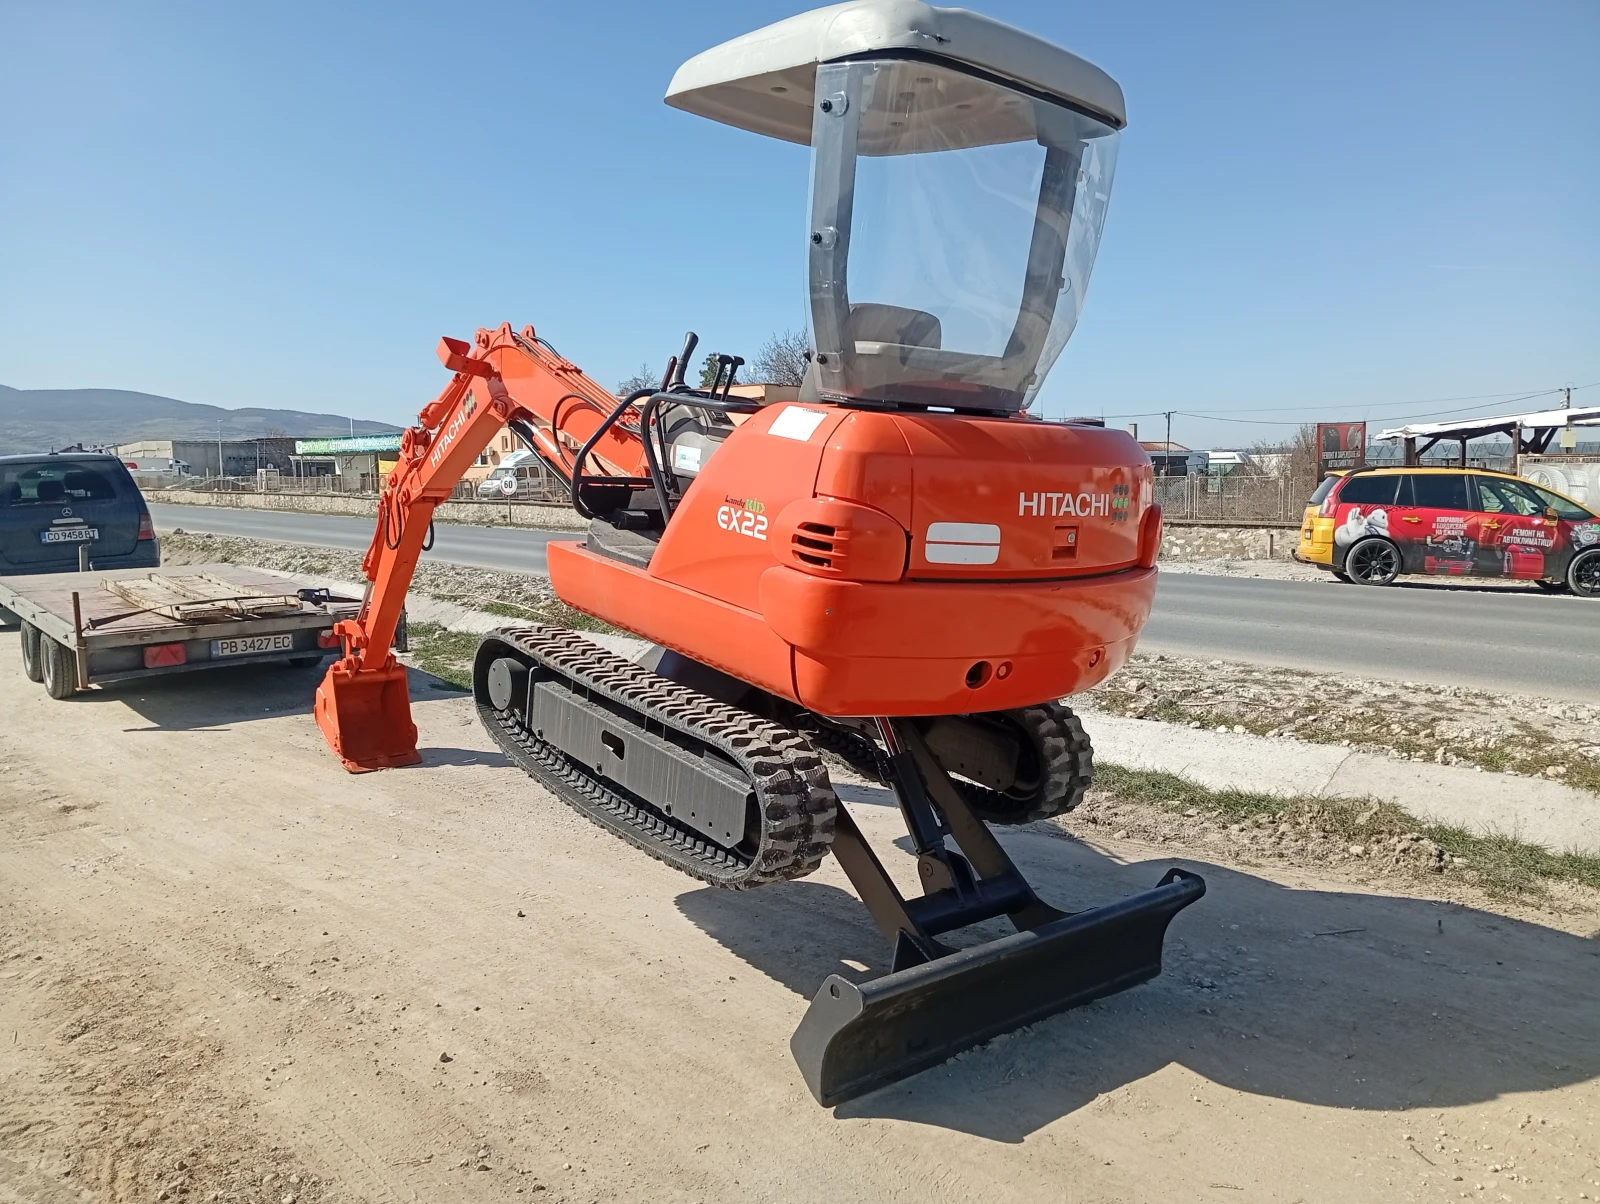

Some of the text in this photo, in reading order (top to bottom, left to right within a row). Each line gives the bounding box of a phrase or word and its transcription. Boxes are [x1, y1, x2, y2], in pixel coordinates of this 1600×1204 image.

[430, 410, 466, 467] HITACHI
[504, 480, 513, 488] 60
[725, 494, 746, 508] Landy
[1018, 492, 1110, 517] HITACHI
[717, 505, 769, 541] EX22
[61, 530, 84, 540] 9458
[1512, 528, 1545, 538] РЕМОНТ НА
[1502, 536, 1554, 547] АВТОКЛИМАТИЦИ
[220, 636, 290, 654] PB 3427 EC
